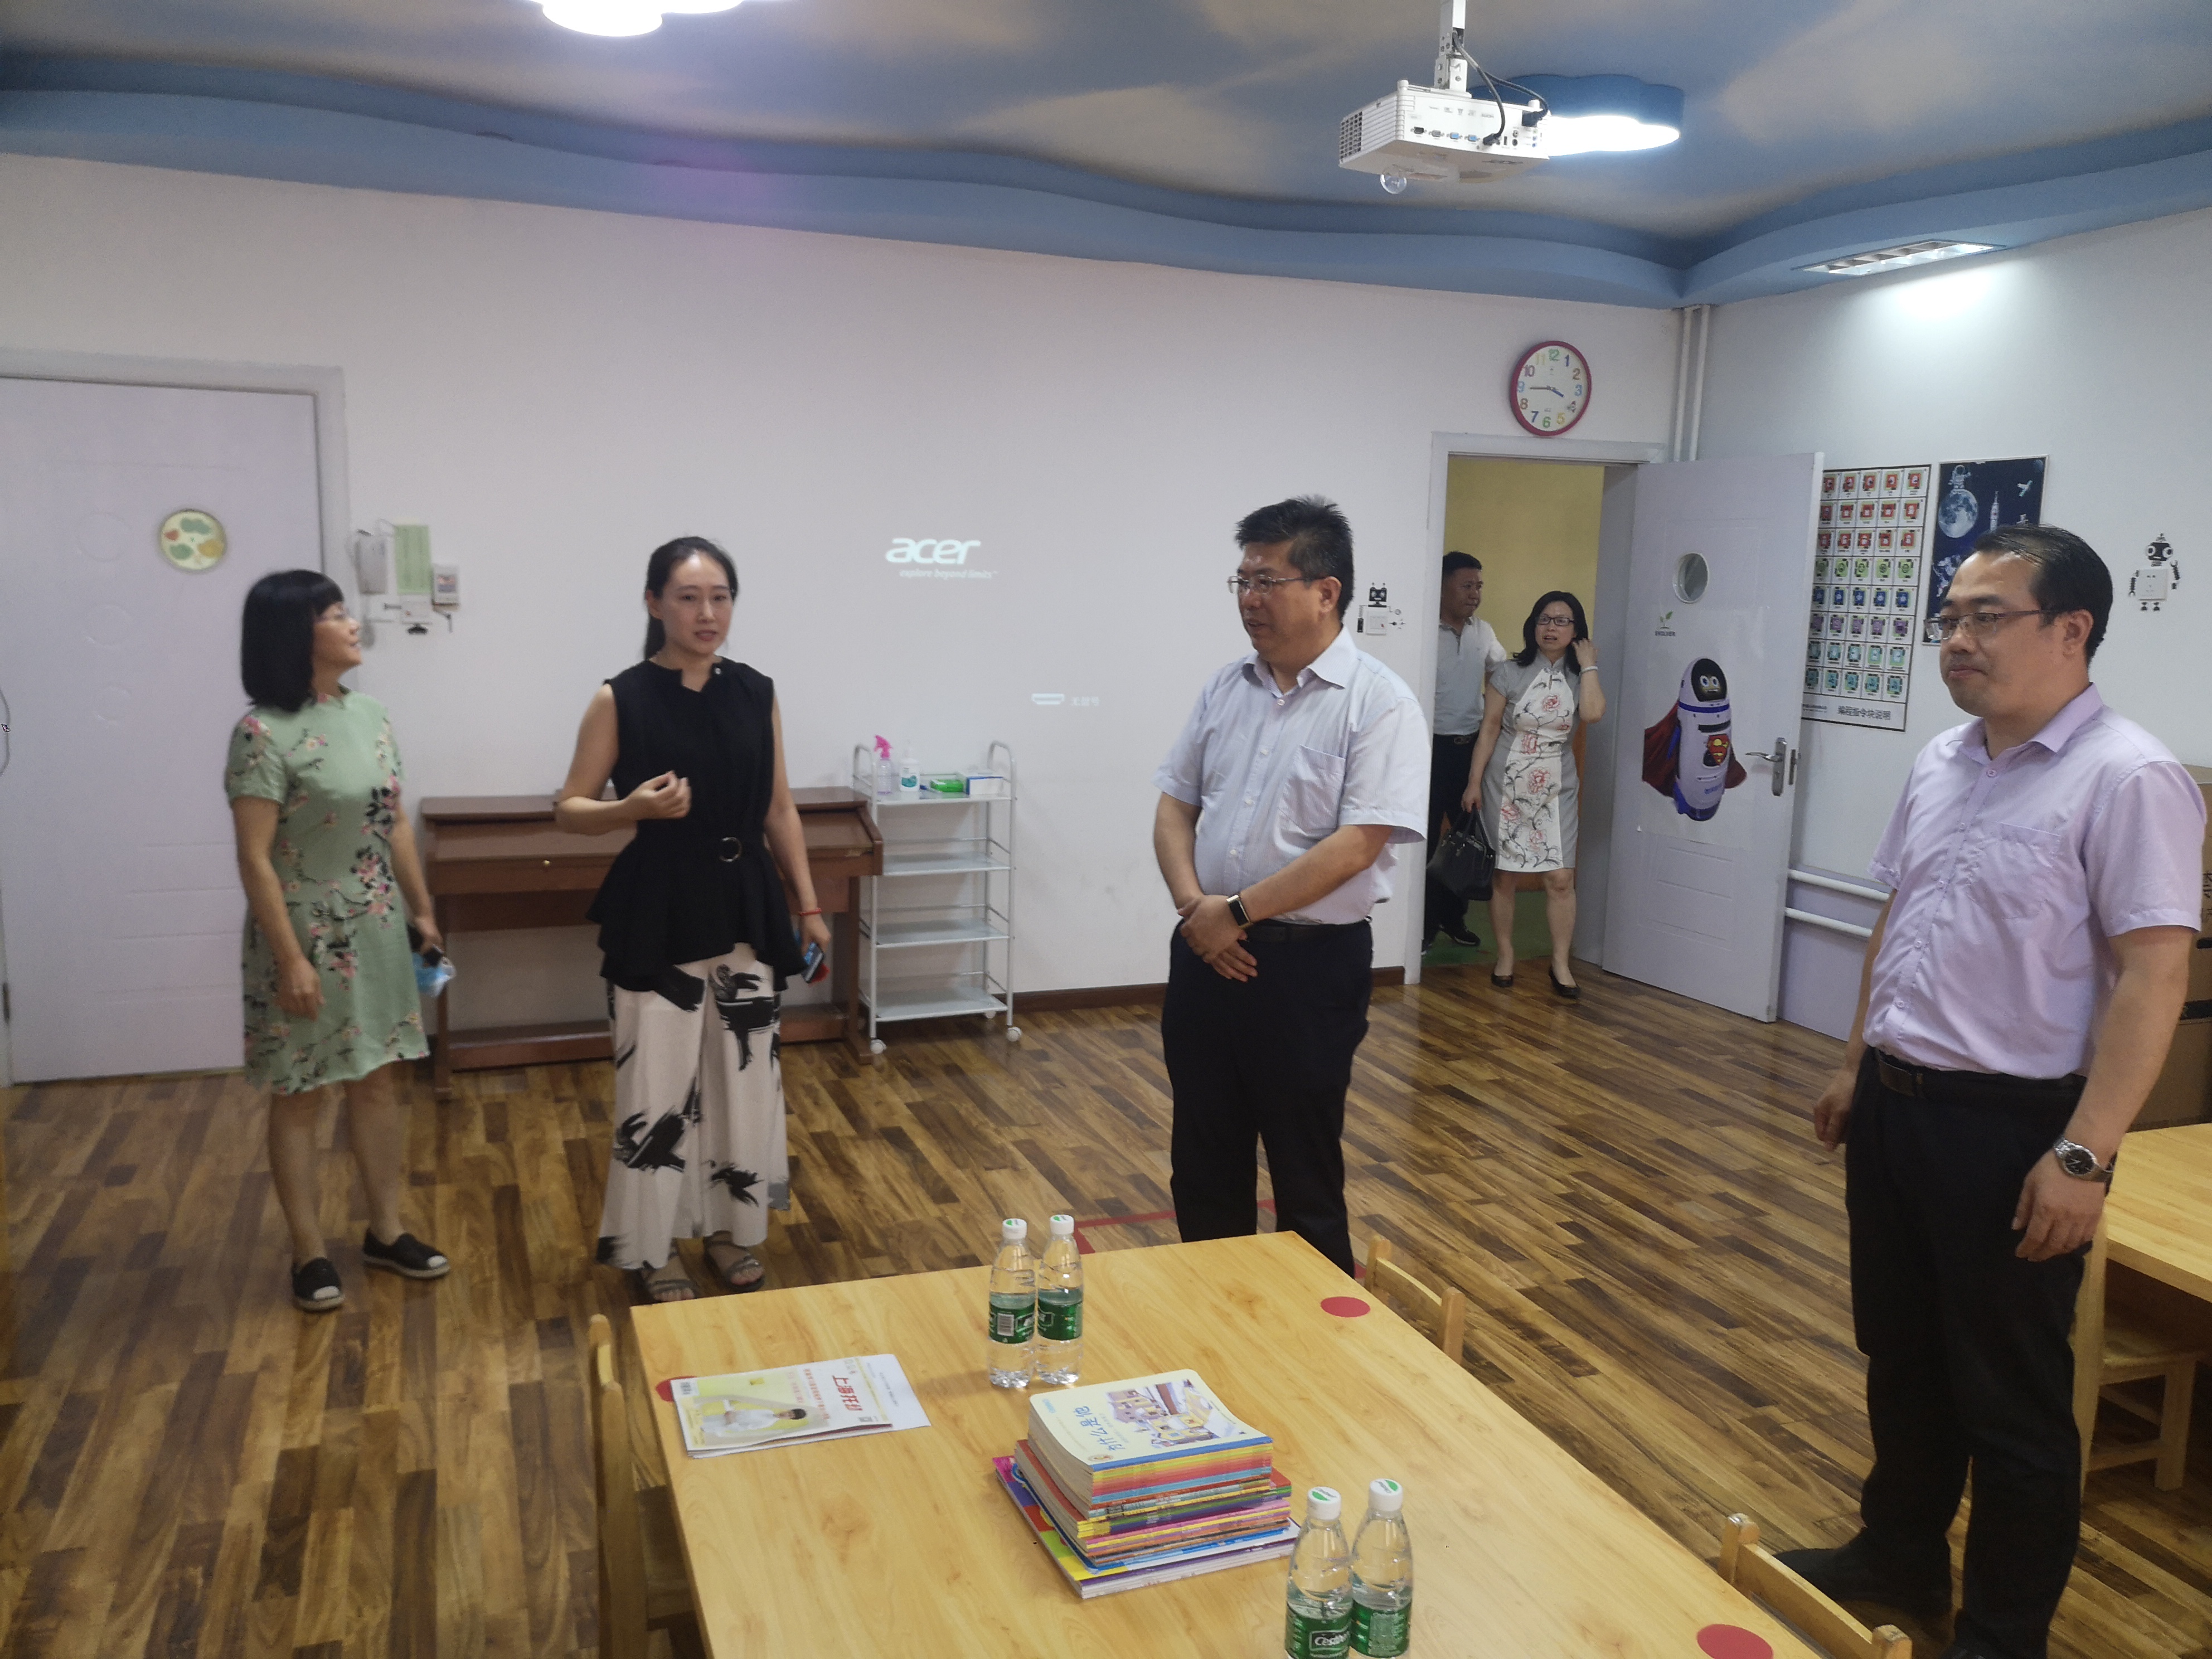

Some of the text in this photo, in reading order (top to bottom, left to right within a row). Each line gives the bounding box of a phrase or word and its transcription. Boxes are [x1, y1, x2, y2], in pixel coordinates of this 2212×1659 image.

[1535, 352, 1546, 366] 11
[1549, 348, 1560, 362] 12
[1565, 354, 1570, 367] 1
[1524, 365, 1535, 377] 10
[1573, 368, 1581, 380] 2
[1517, 381, 1525, 393] 9
[1574, 384, 1583, 396] 3
[1520, 398, 1529, 410] 8
[1567, 400, 1576, 413] 4
[1531, 411, 1539, 423] 7
[1542, 416, 1551, 428] 6
[1556, 412, 1565, 425] 5
[885, 537, 981, 564] acer
